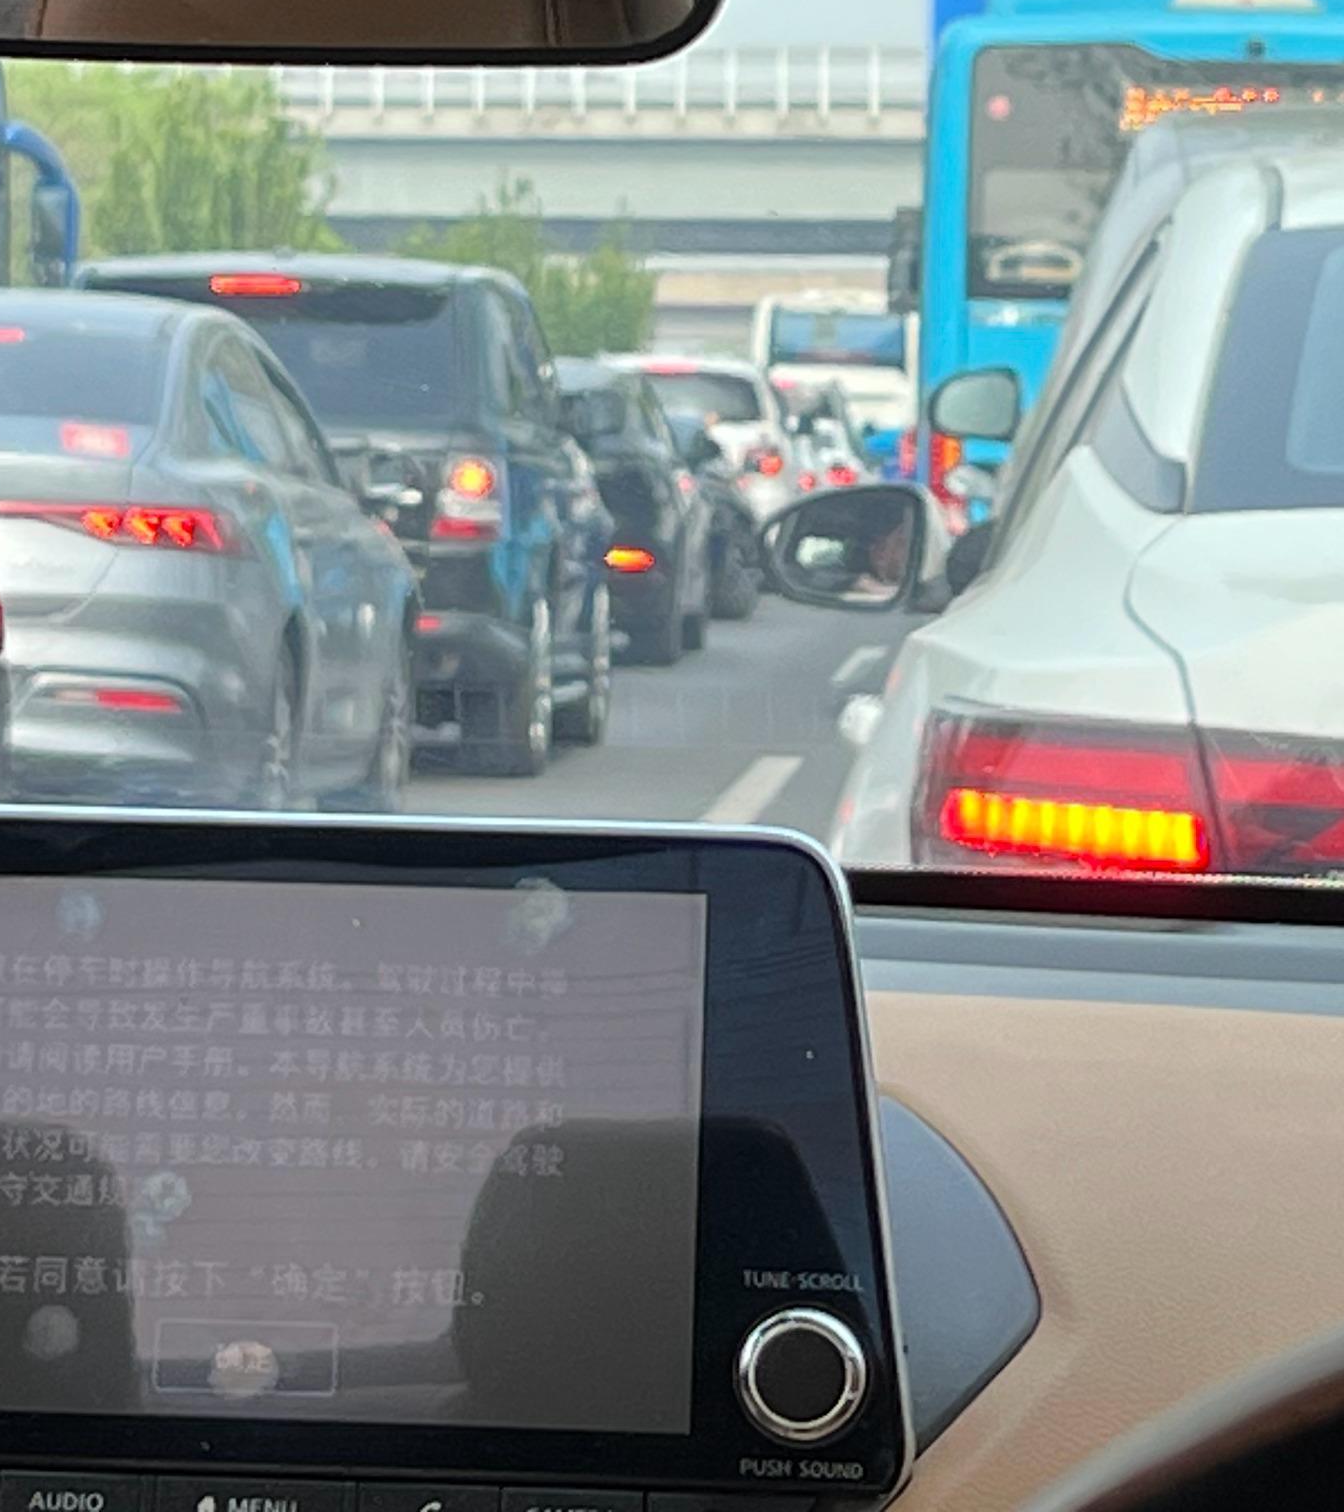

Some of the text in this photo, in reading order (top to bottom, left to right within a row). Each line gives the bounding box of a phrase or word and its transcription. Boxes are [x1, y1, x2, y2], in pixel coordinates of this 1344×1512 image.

[739, 1458, 864, 1480] PUSH SOUND
[29, 1491, 105, 1511] AUDIO
